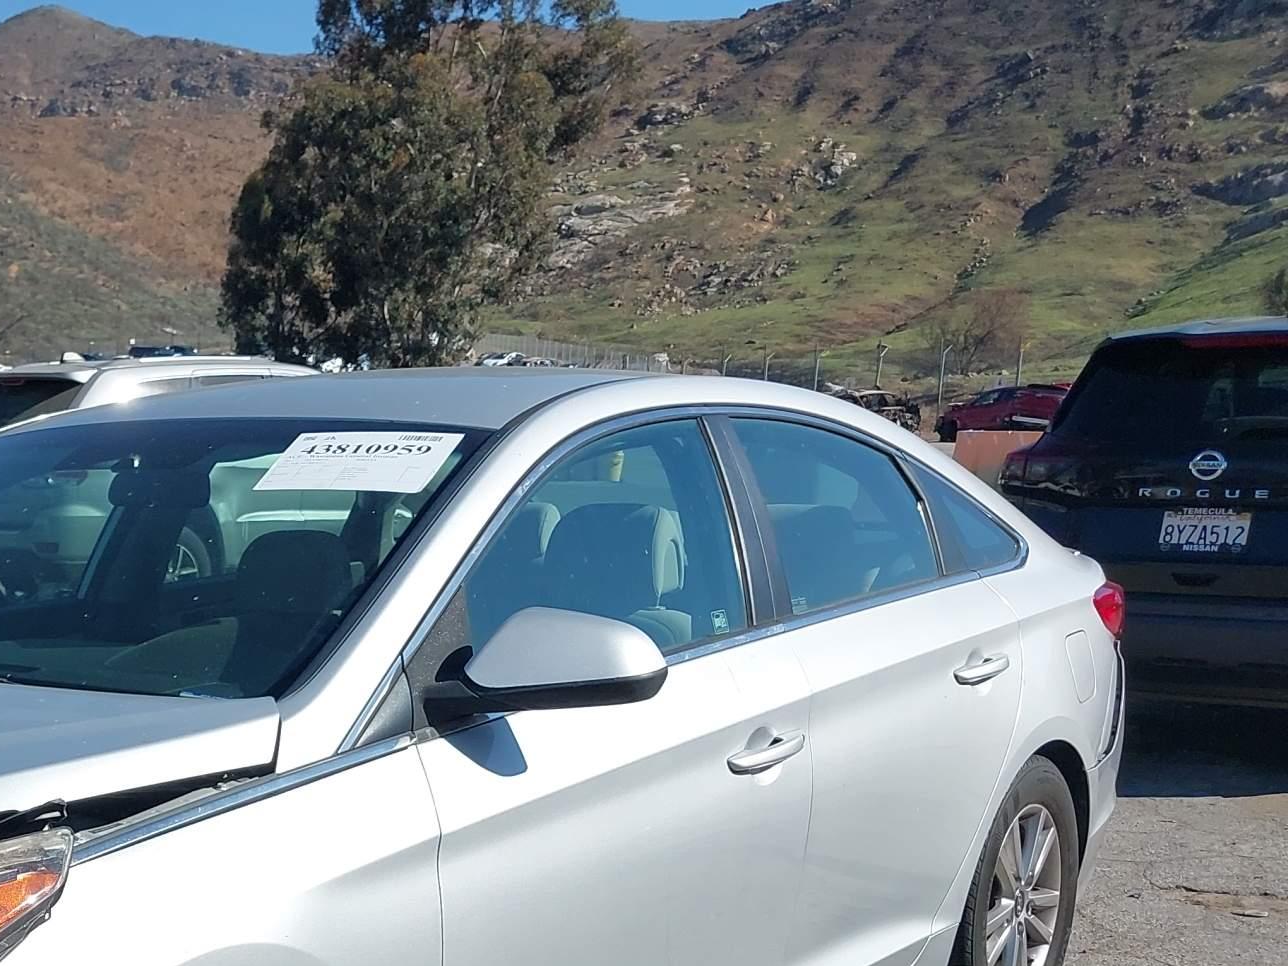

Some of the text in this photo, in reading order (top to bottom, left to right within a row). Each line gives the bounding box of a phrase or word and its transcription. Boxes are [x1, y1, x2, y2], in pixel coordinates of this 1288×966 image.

[301, 443, 432, 455] 43810959
[1139, 488, 1271, 499] ROGUE
[1163, 524, 1245, 545] 8YZA512
[1182, 544, 1219, 552] NISSAN
